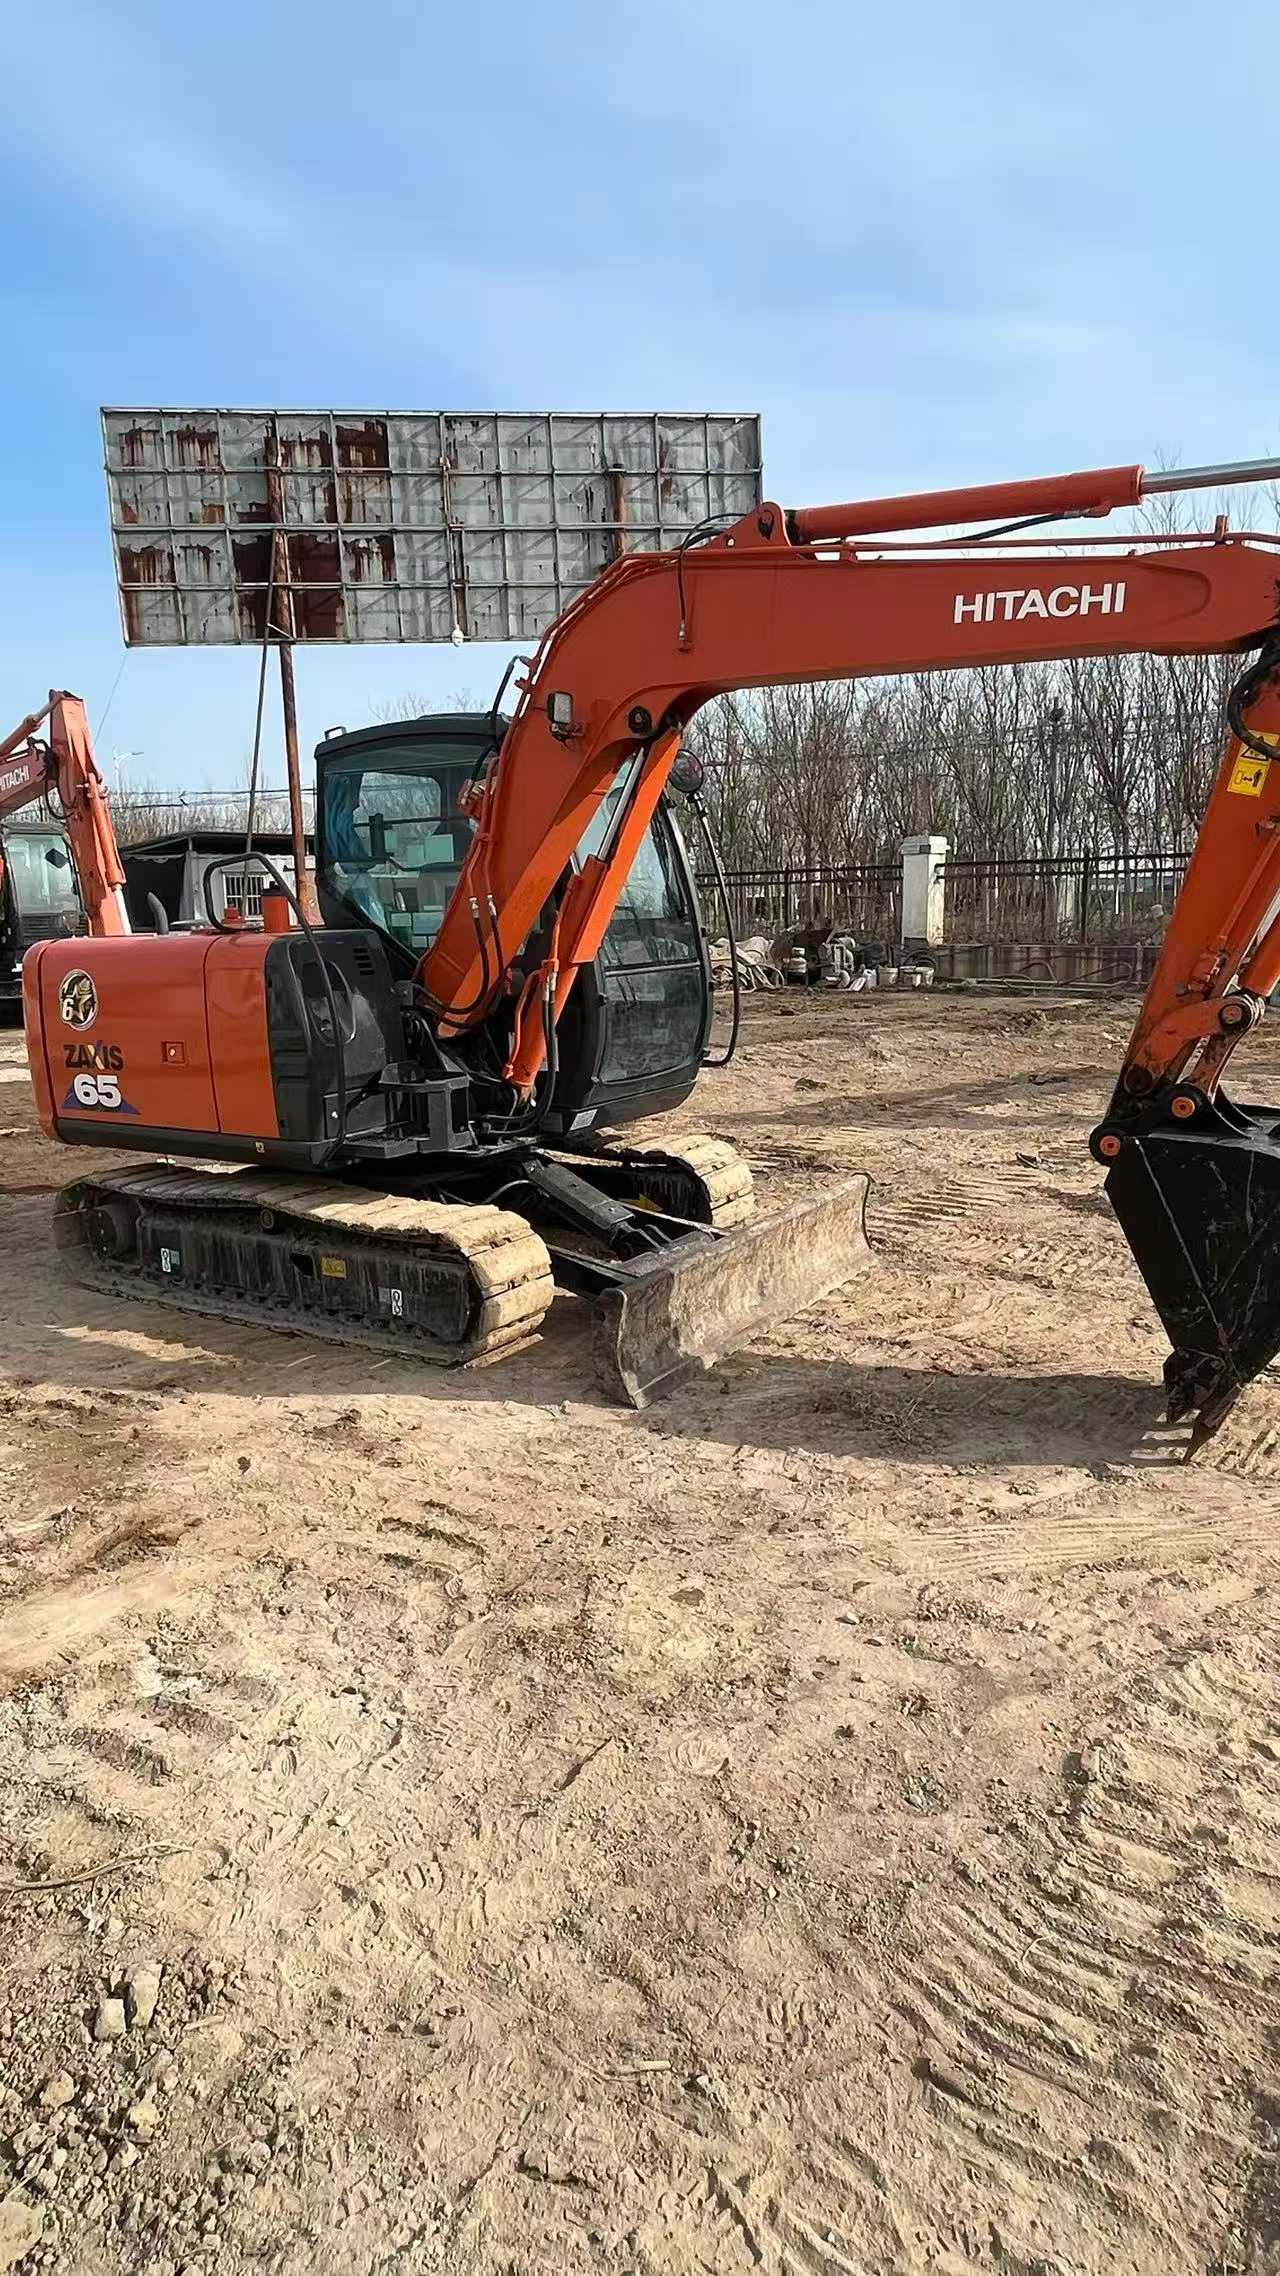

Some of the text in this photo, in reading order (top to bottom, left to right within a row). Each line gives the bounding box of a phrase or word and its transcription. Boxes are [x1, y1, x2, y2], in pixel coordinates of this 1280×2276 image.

[953, 582, 1127, 624] HITACHI
[63, 1041, 124, 1071] ZAXIS
[73, 1073, 122, 1108] 65
